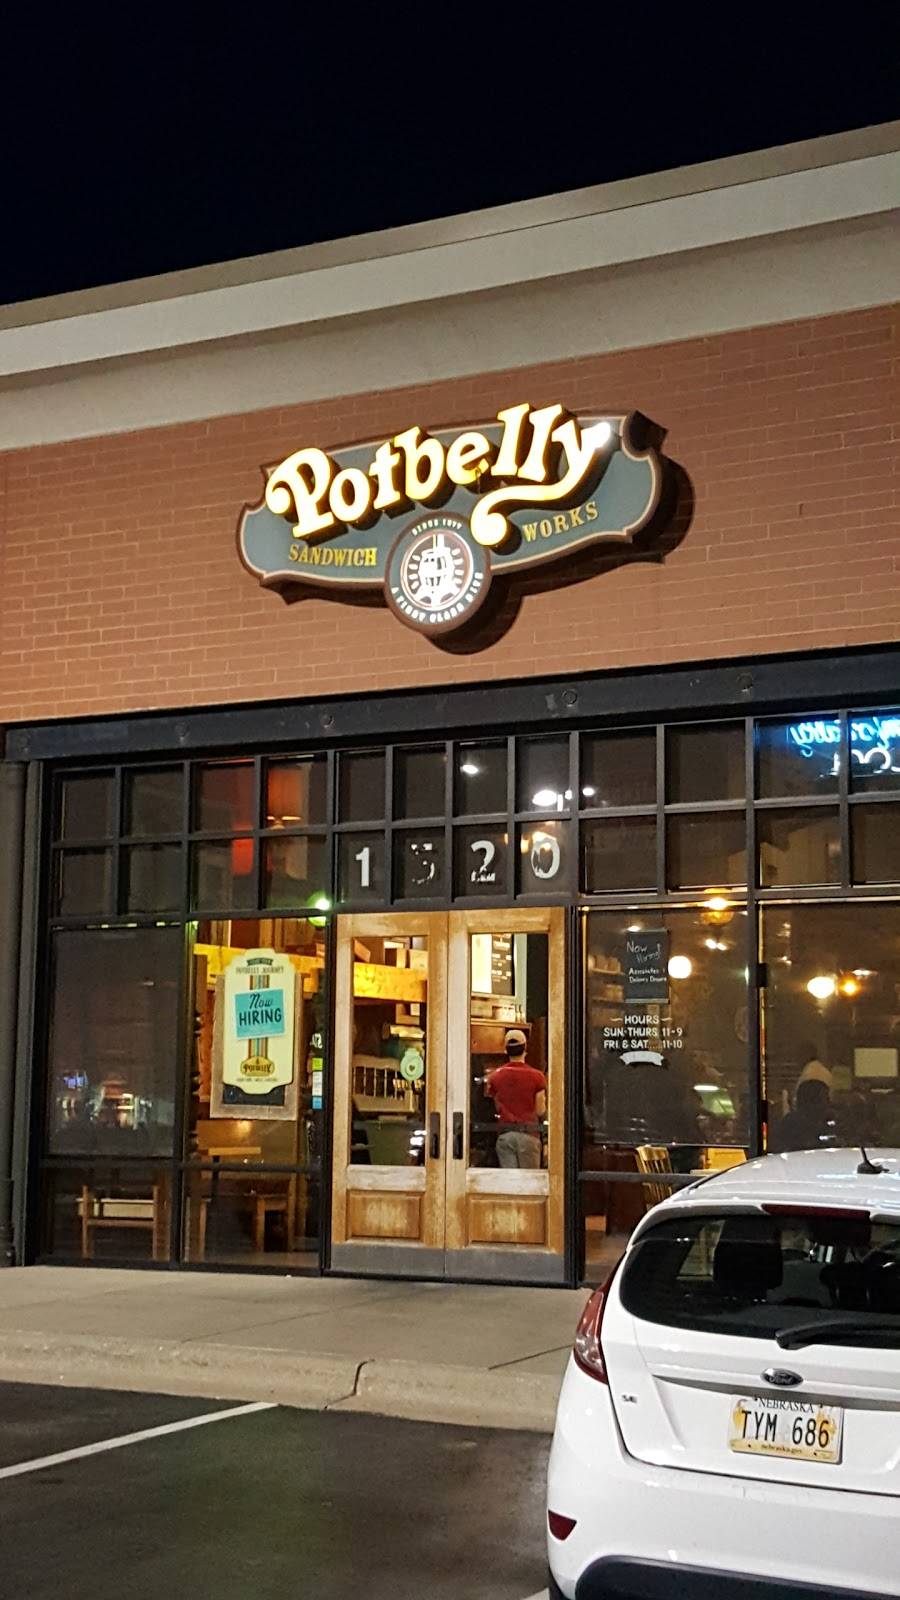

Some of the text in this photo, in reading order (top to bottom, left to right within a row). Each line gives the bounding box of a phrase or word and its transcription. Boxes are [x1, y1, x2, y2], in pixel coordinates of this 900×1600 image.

[265, 403, 611, 546] Potbelly
[288, 501, 598, 567] SANDWICH WORKS
[626, 940, 648, 953] Now
[249, 993, 273, 1009] Now
[239, 1008, 282, 1026] HIRING
[624, 1014, 659, 1025] HOURS
[622, 1039, 629, 1049] &
[757, 1397, 814, 1414] NEBRASKA
[741, 1410, 829, 1448] TYM 686
